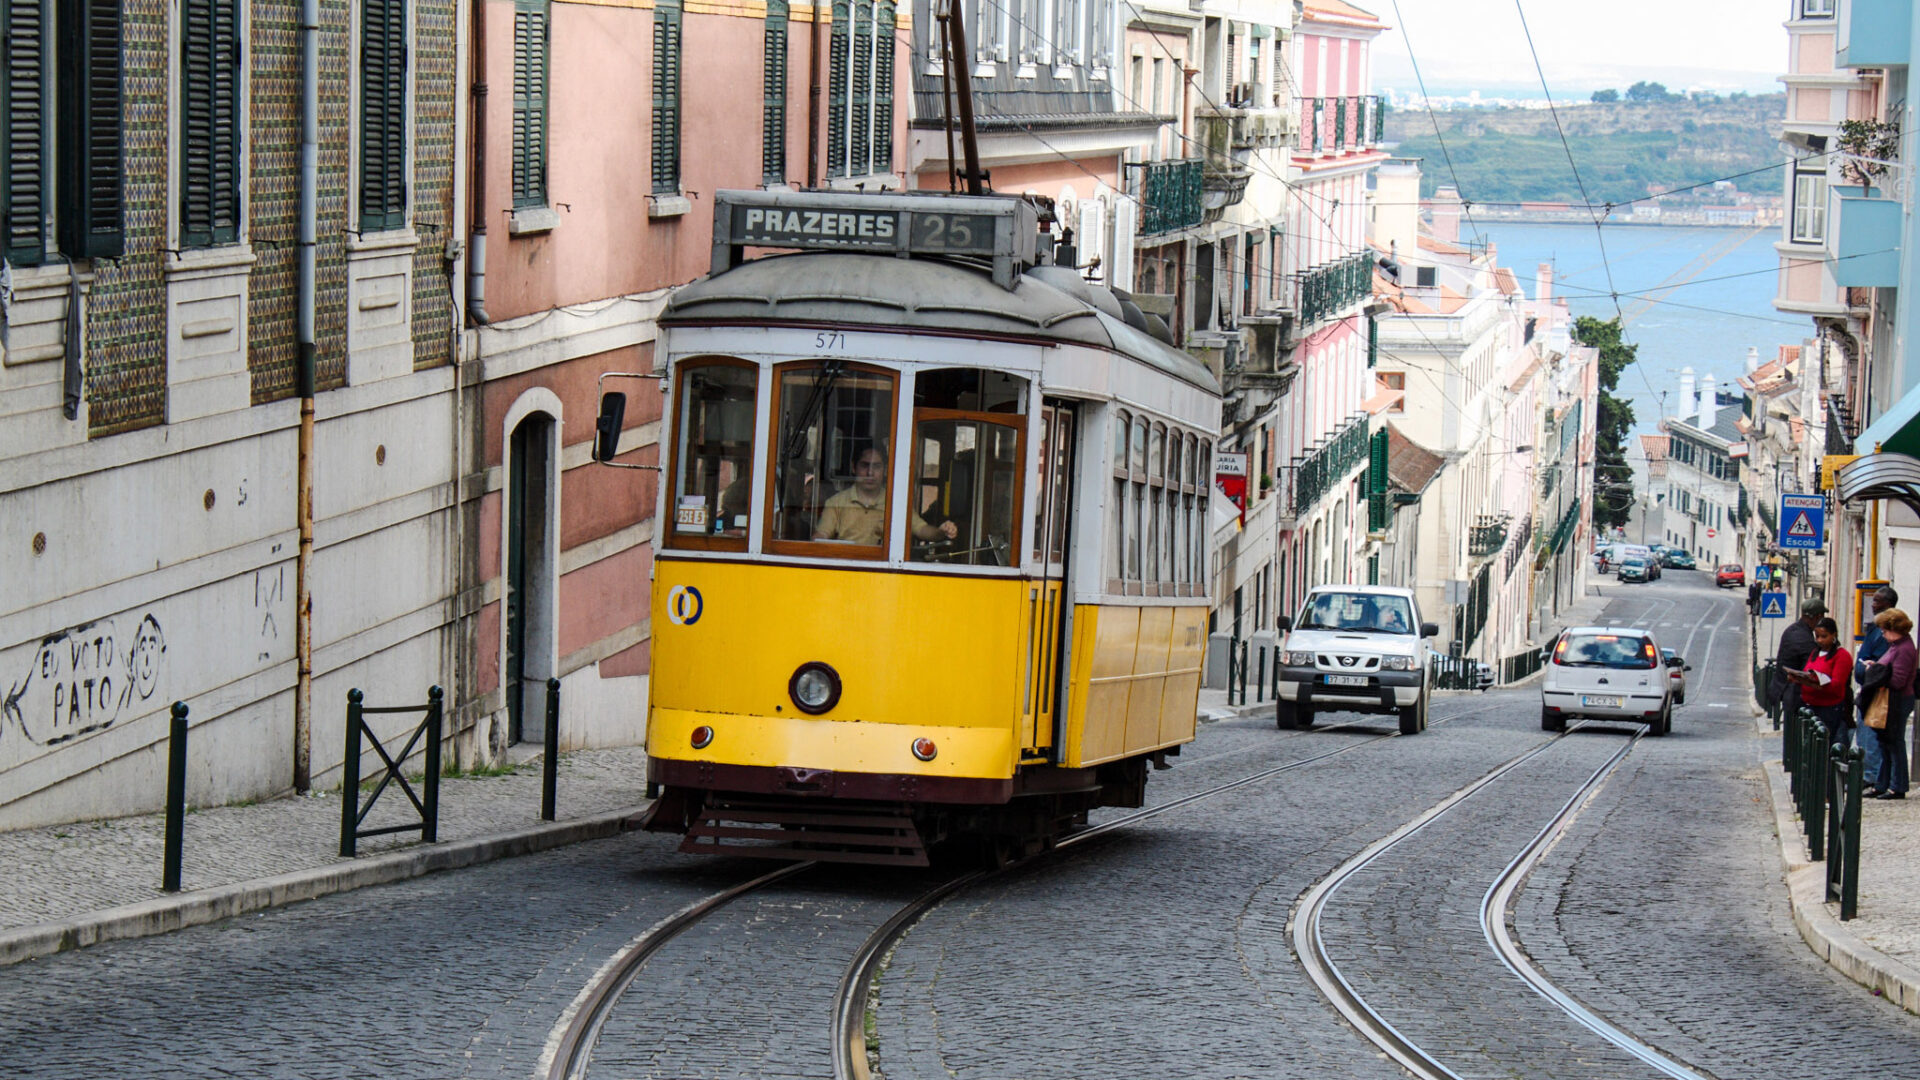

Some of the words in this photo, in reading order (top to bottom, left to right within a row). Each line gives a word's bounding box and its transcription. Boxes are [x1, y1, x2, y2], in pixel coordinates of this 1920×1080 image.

[745, 208, 895, 238] PRAZERES
[922, 214, 972, 247] 25
[815, 332, 845, 350] 571
[1786, 498, 1820, 507] ATENÇÃO
[1786, 537, 1816, 547] Escola
[53, 676, 112, 727] PATO
